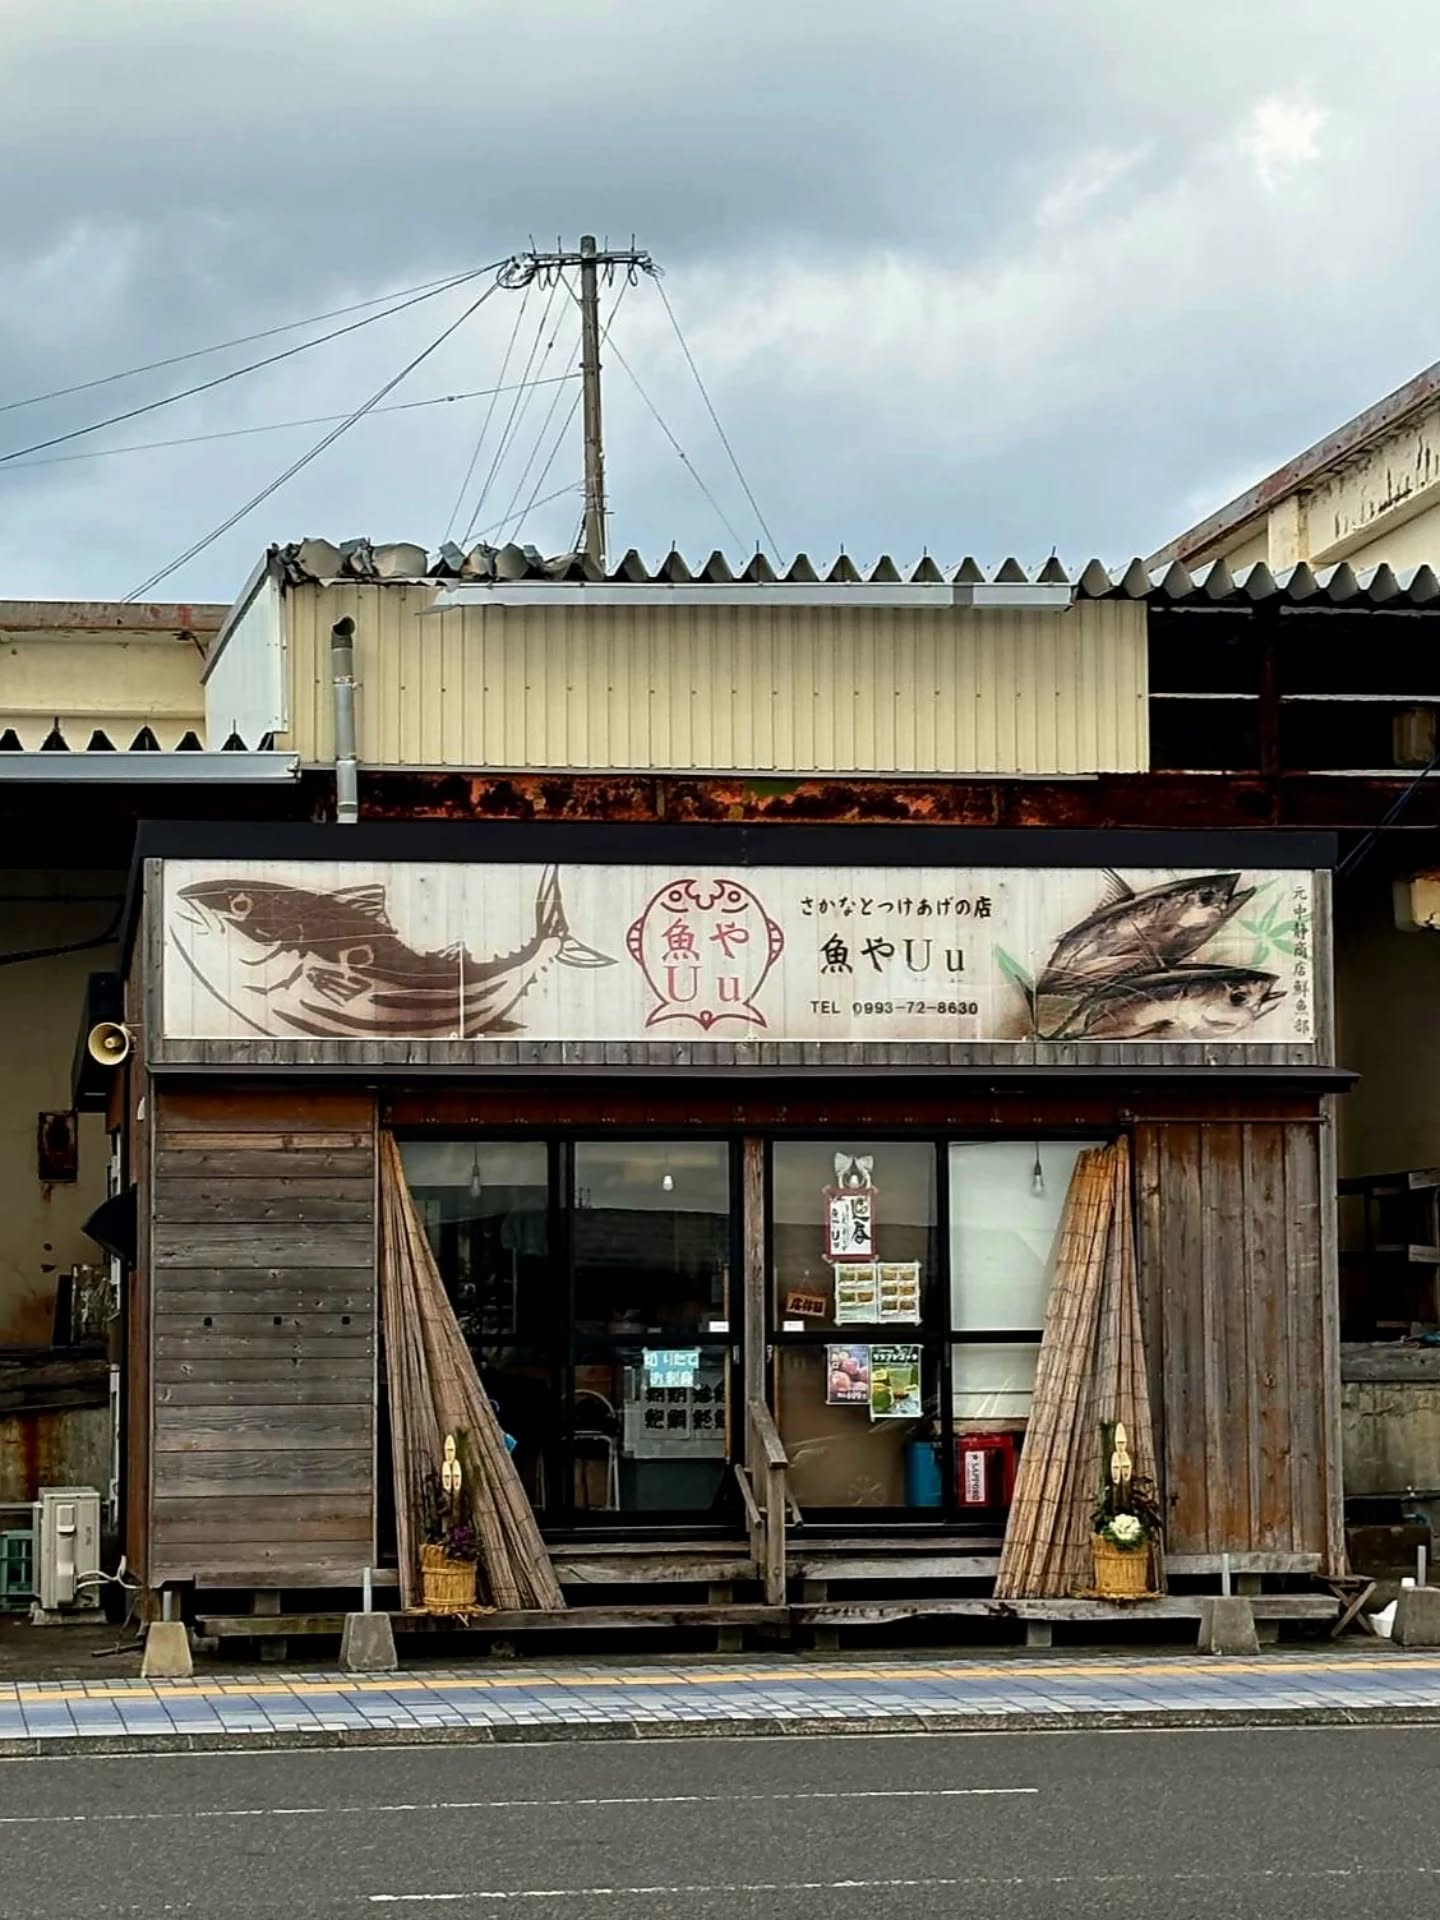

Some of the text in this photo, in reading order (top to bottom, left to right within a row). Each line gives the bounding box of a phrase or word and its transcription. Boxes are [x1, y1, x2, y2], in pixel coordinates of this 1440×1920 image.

[800, 896, 992, 918] さかなとつけあげの店
[661, 918, 749, 961] 魚や
[810, 1001, 979, 1014] TEL 0993-72-8630
